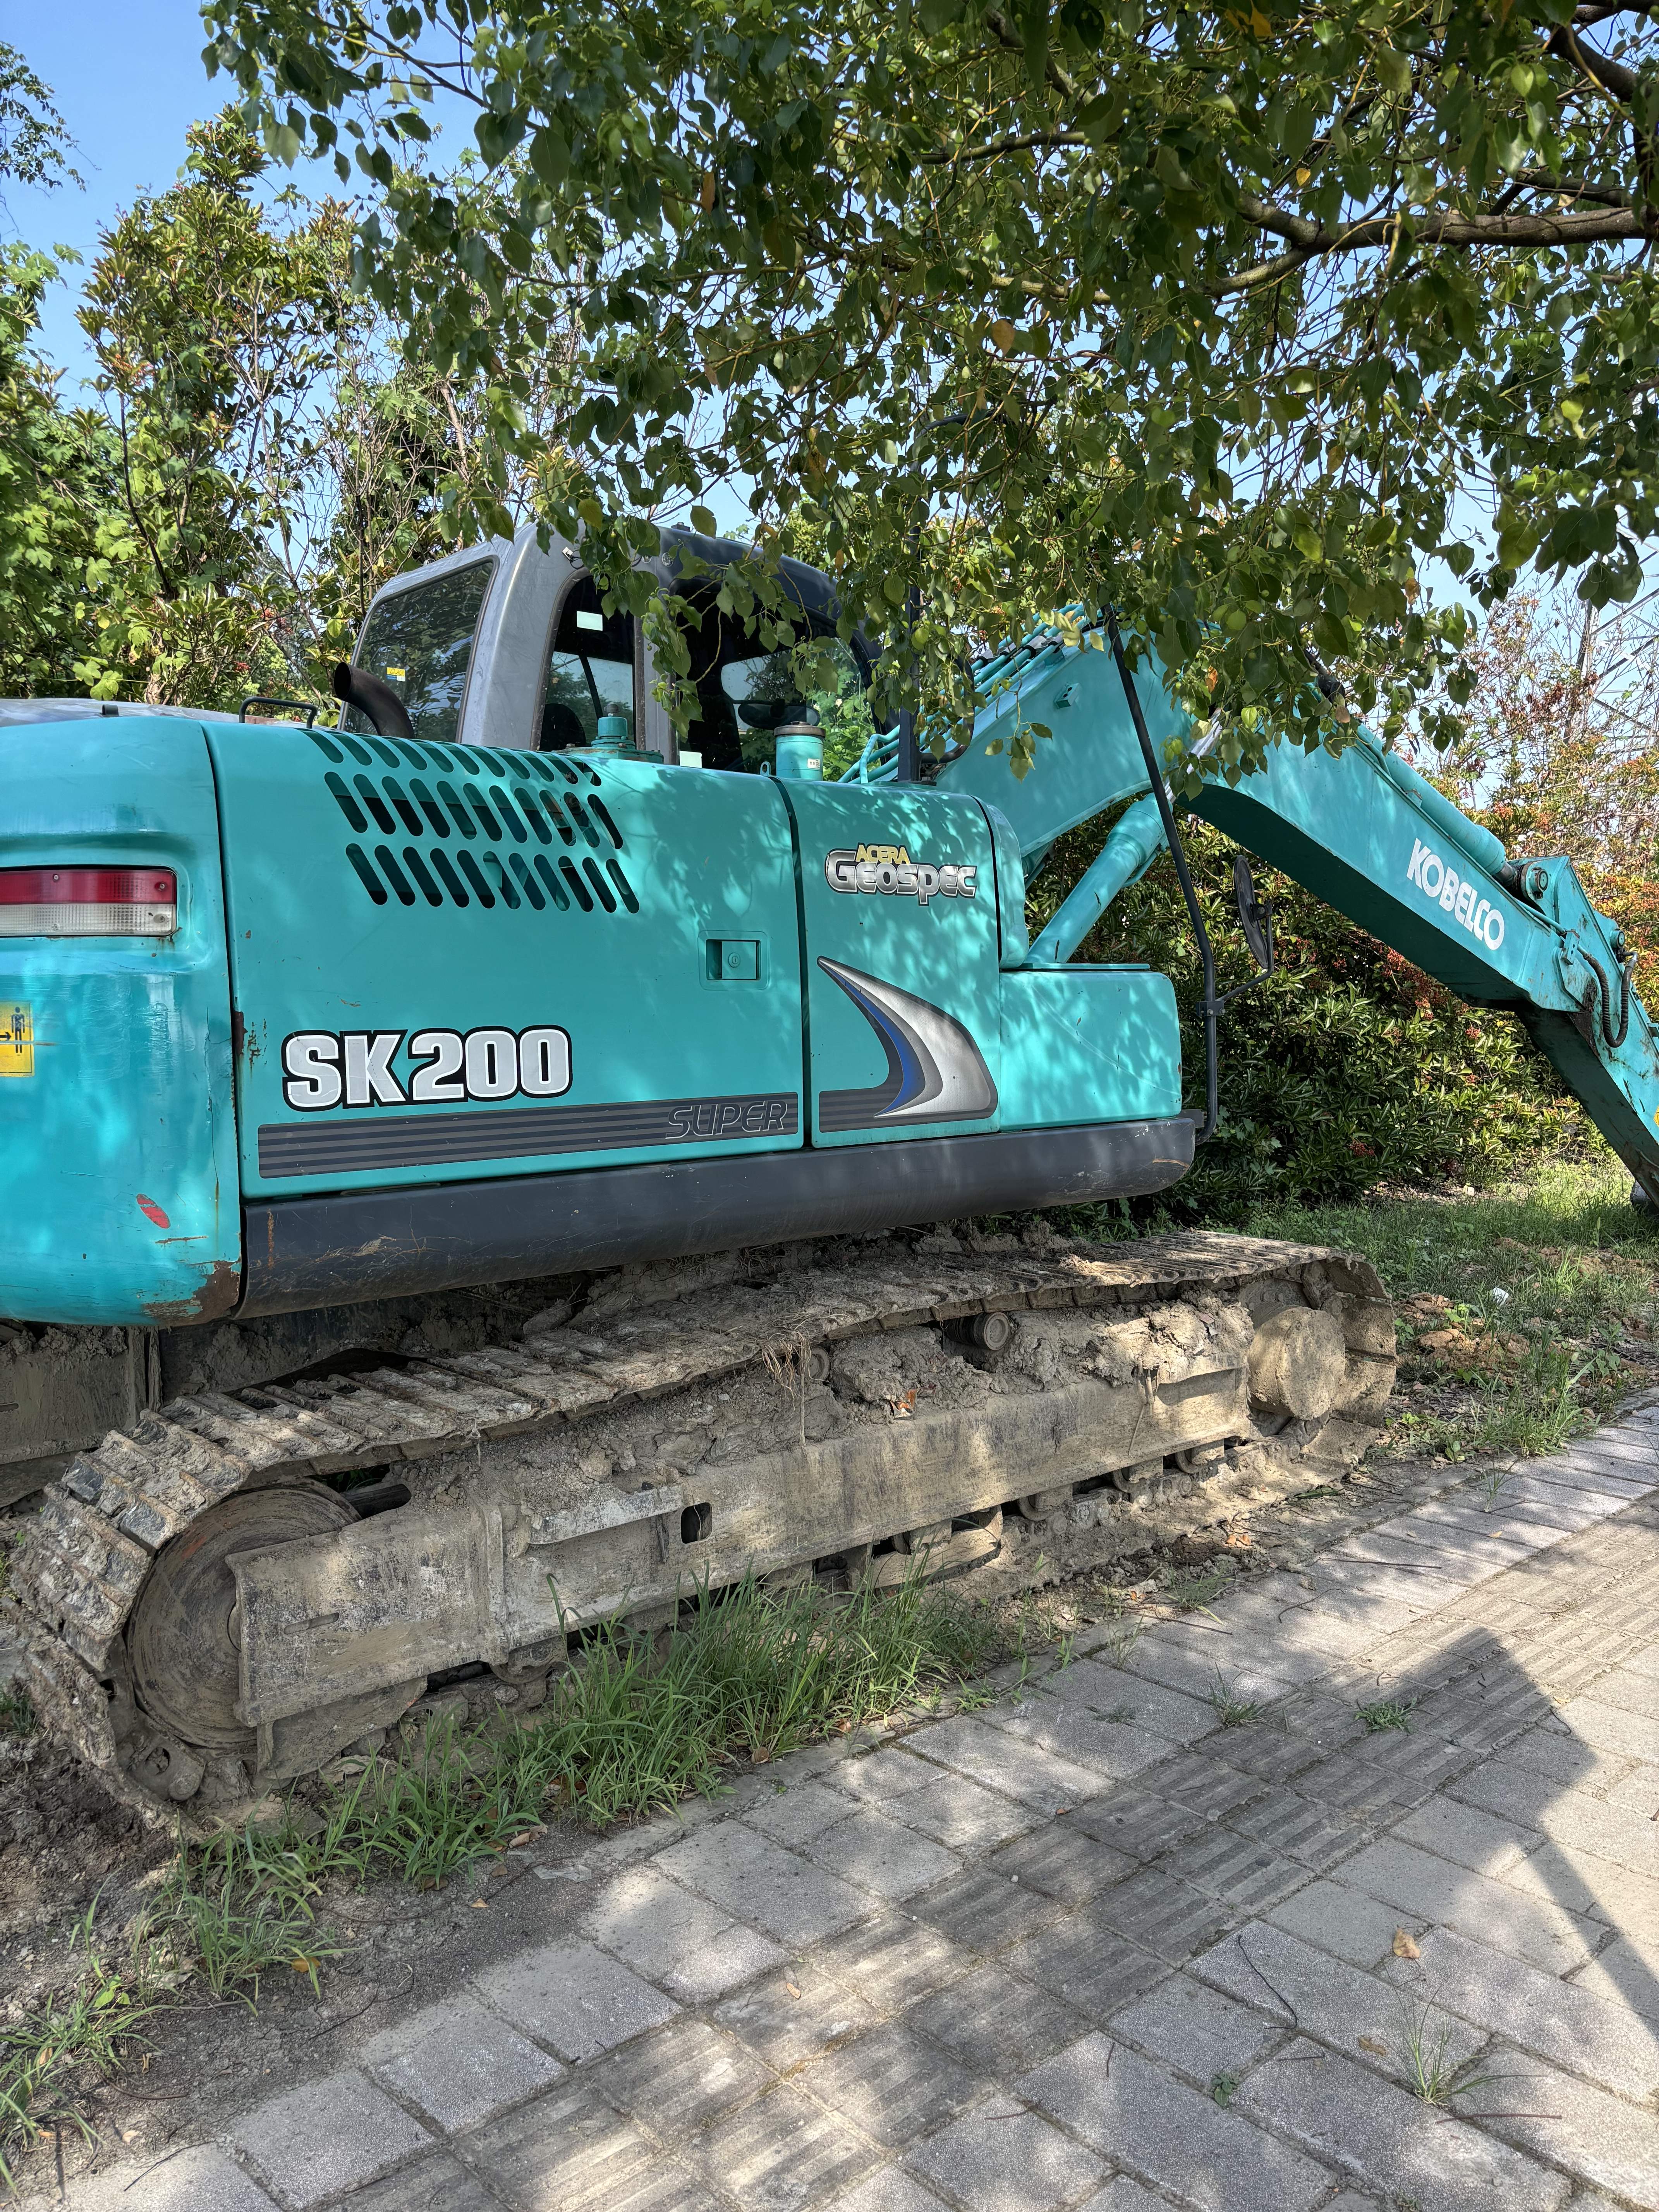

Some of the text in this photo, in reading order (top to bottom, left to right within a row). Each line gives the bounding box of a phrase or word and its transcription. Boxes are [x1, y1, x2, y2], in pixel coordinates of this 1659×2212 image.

[855, 843, 910, 865] ACERA
[1407, 838, 1505, 950] KOBELCO
[282, 1025, 572, 1111] SK200
[665, 1100, 787, 1139] SUPER
